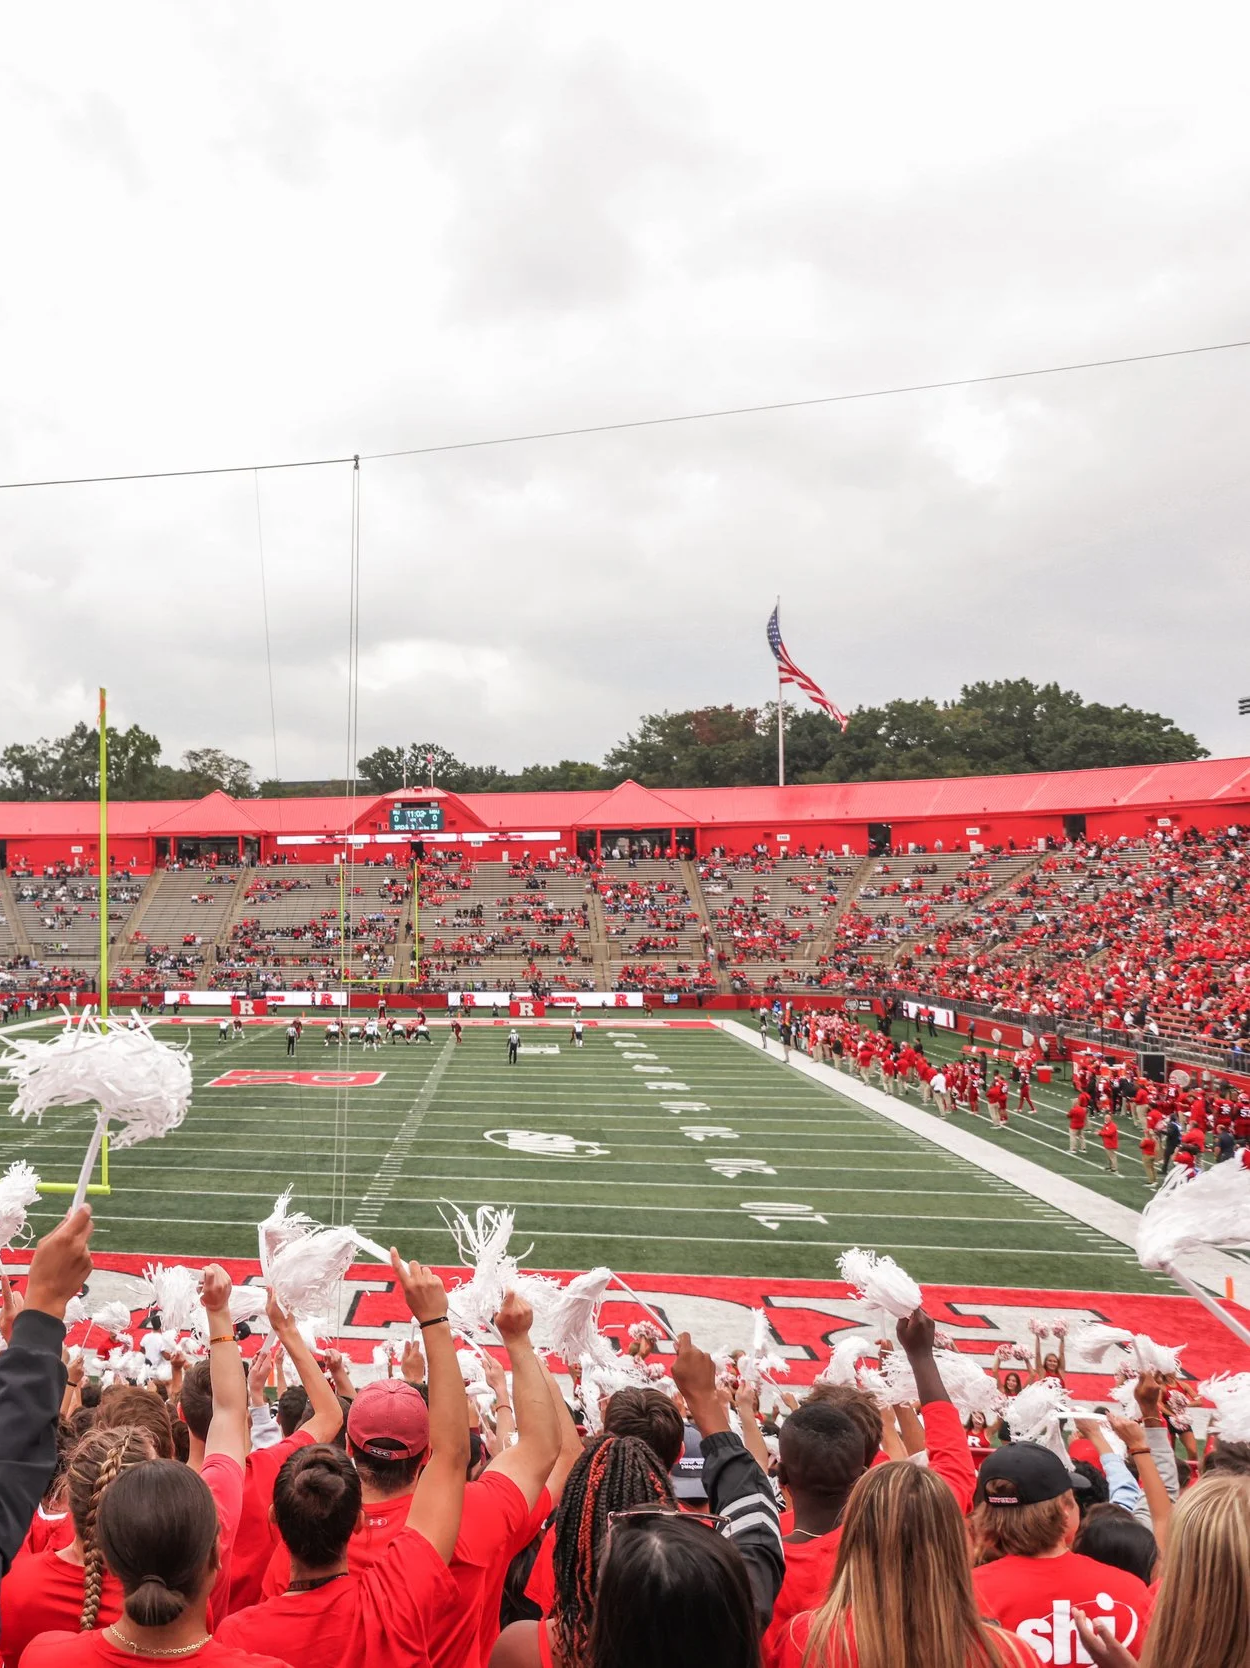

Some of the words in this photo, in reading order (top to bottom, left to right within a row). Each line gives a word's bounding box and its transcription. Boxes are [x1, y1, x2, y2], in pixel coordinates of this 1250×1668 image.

[178, 993, 191, 1005] R
[320, 994, 334, 1006] R
[615, 994, 629, 1006] R
[239, 1000, 255, 1015] R
[519, 1002, 535, 1016] R
[739, 1201, 829, 1225] 10
[967, 1435, 982, 1448] R
